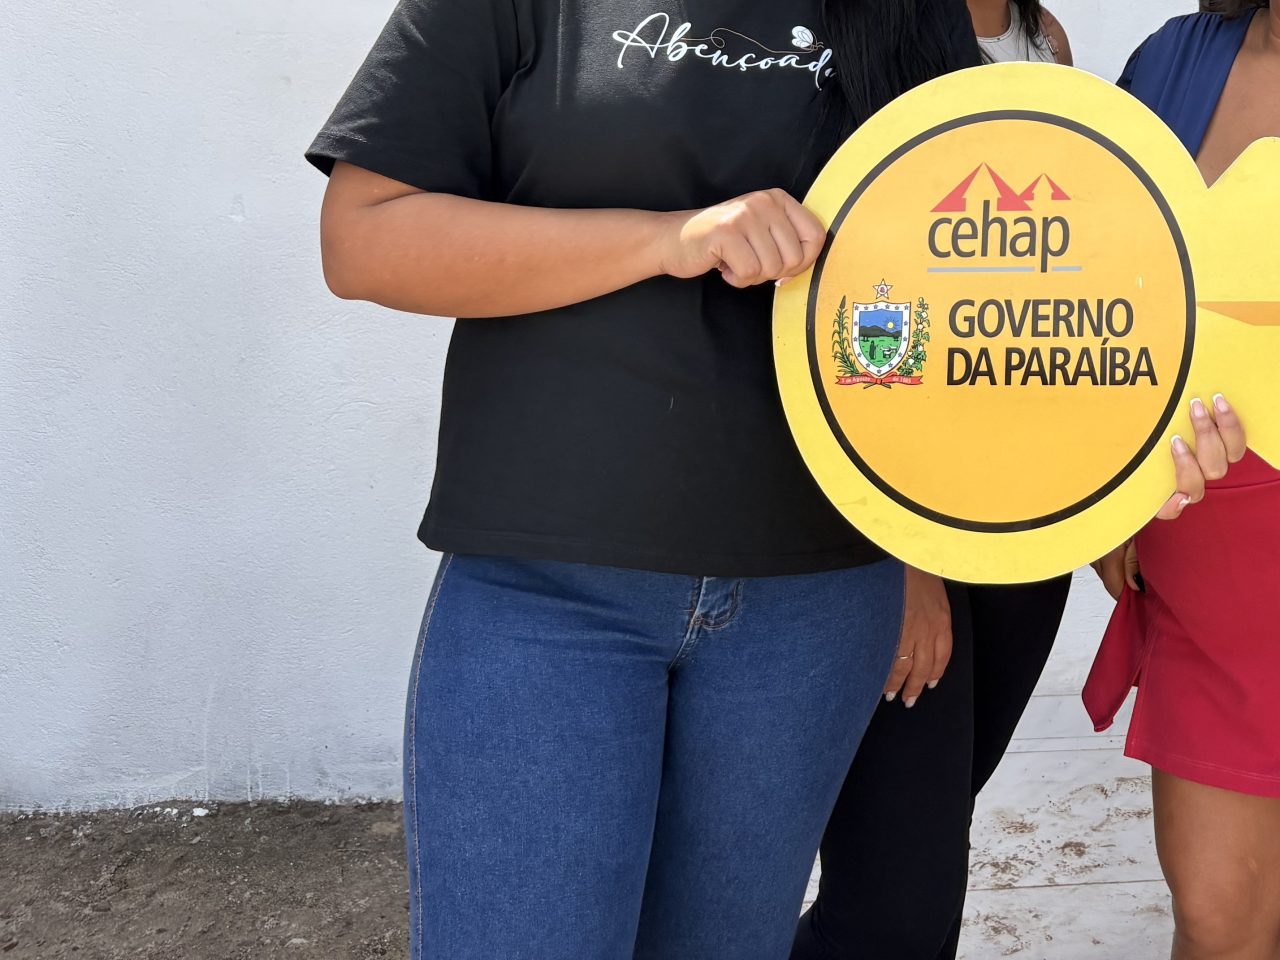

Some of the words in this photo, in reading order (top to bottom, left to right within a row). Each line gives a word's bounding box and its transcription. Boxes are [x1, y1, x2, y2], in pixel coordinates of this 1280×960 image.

[927, 199, 1071, 273] cehap
[948, 297, 1134, 338] GOVERNO
[946, 347, 998, 386] DA
[1004, 336, 1159, 386] PARAÍBA
